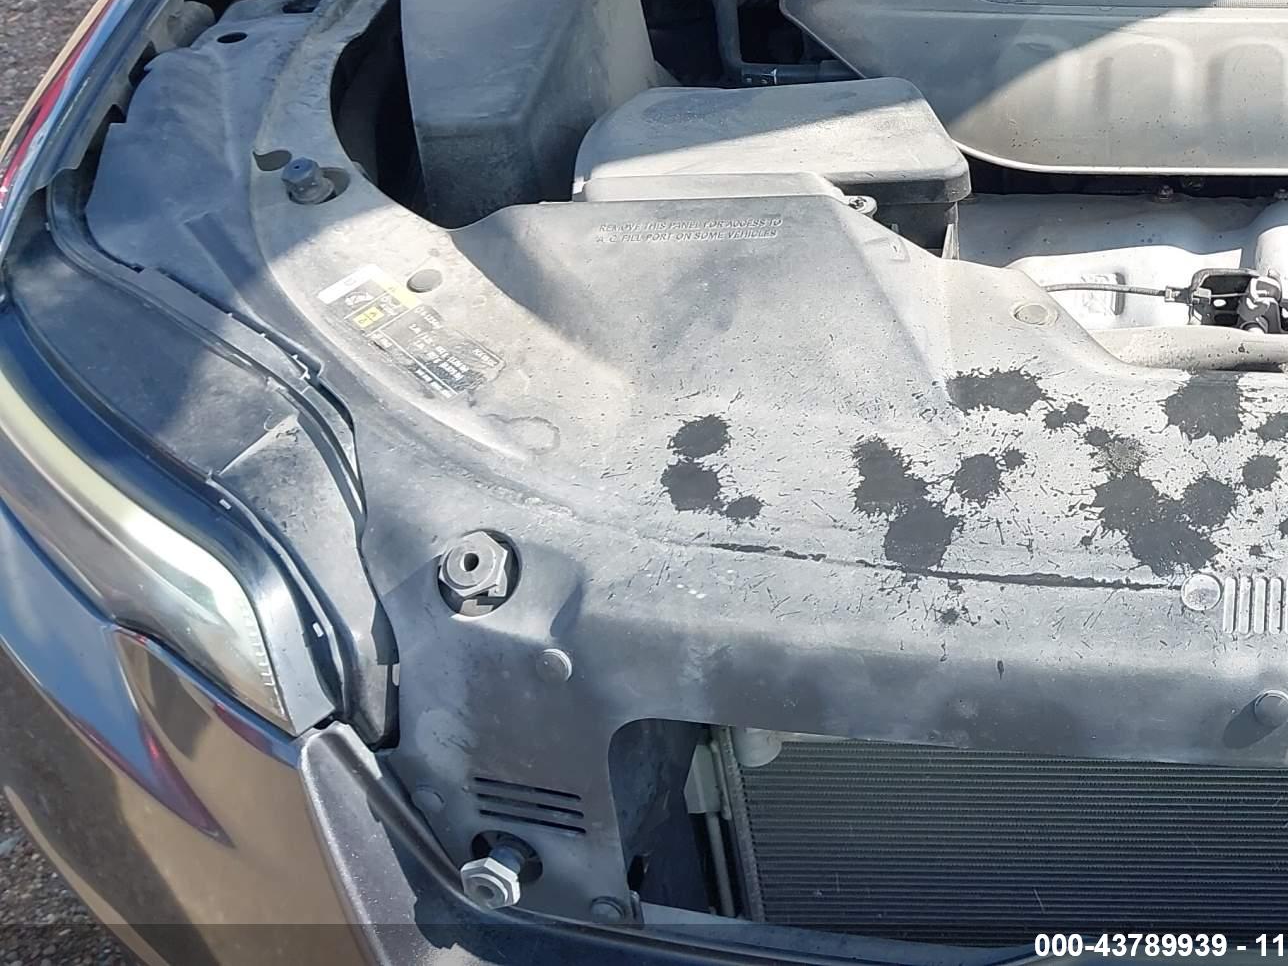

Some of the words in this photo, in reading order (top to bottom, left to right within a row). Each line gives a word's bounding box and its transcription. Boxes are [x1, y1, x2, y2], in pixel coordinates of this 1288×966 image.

[600, 222, 641, 233] REMOVE
[645, 221, 667, 232] THIS
[668, 220, 700, 231] PANEL
[704, 219, 724, 230] FOR
[725, 218, 766, 229] ACCESS
[768, 217, 783, 228] TO
[597, 233, 617, 243] AC
[621, 233, 642, 243] FILL
[645, 232, 673, 243] PORT
[674, 231, 691, 242] ON
[694, 230, 724, 241] SOME
[727, 228, 778, 240] VEHICLES
